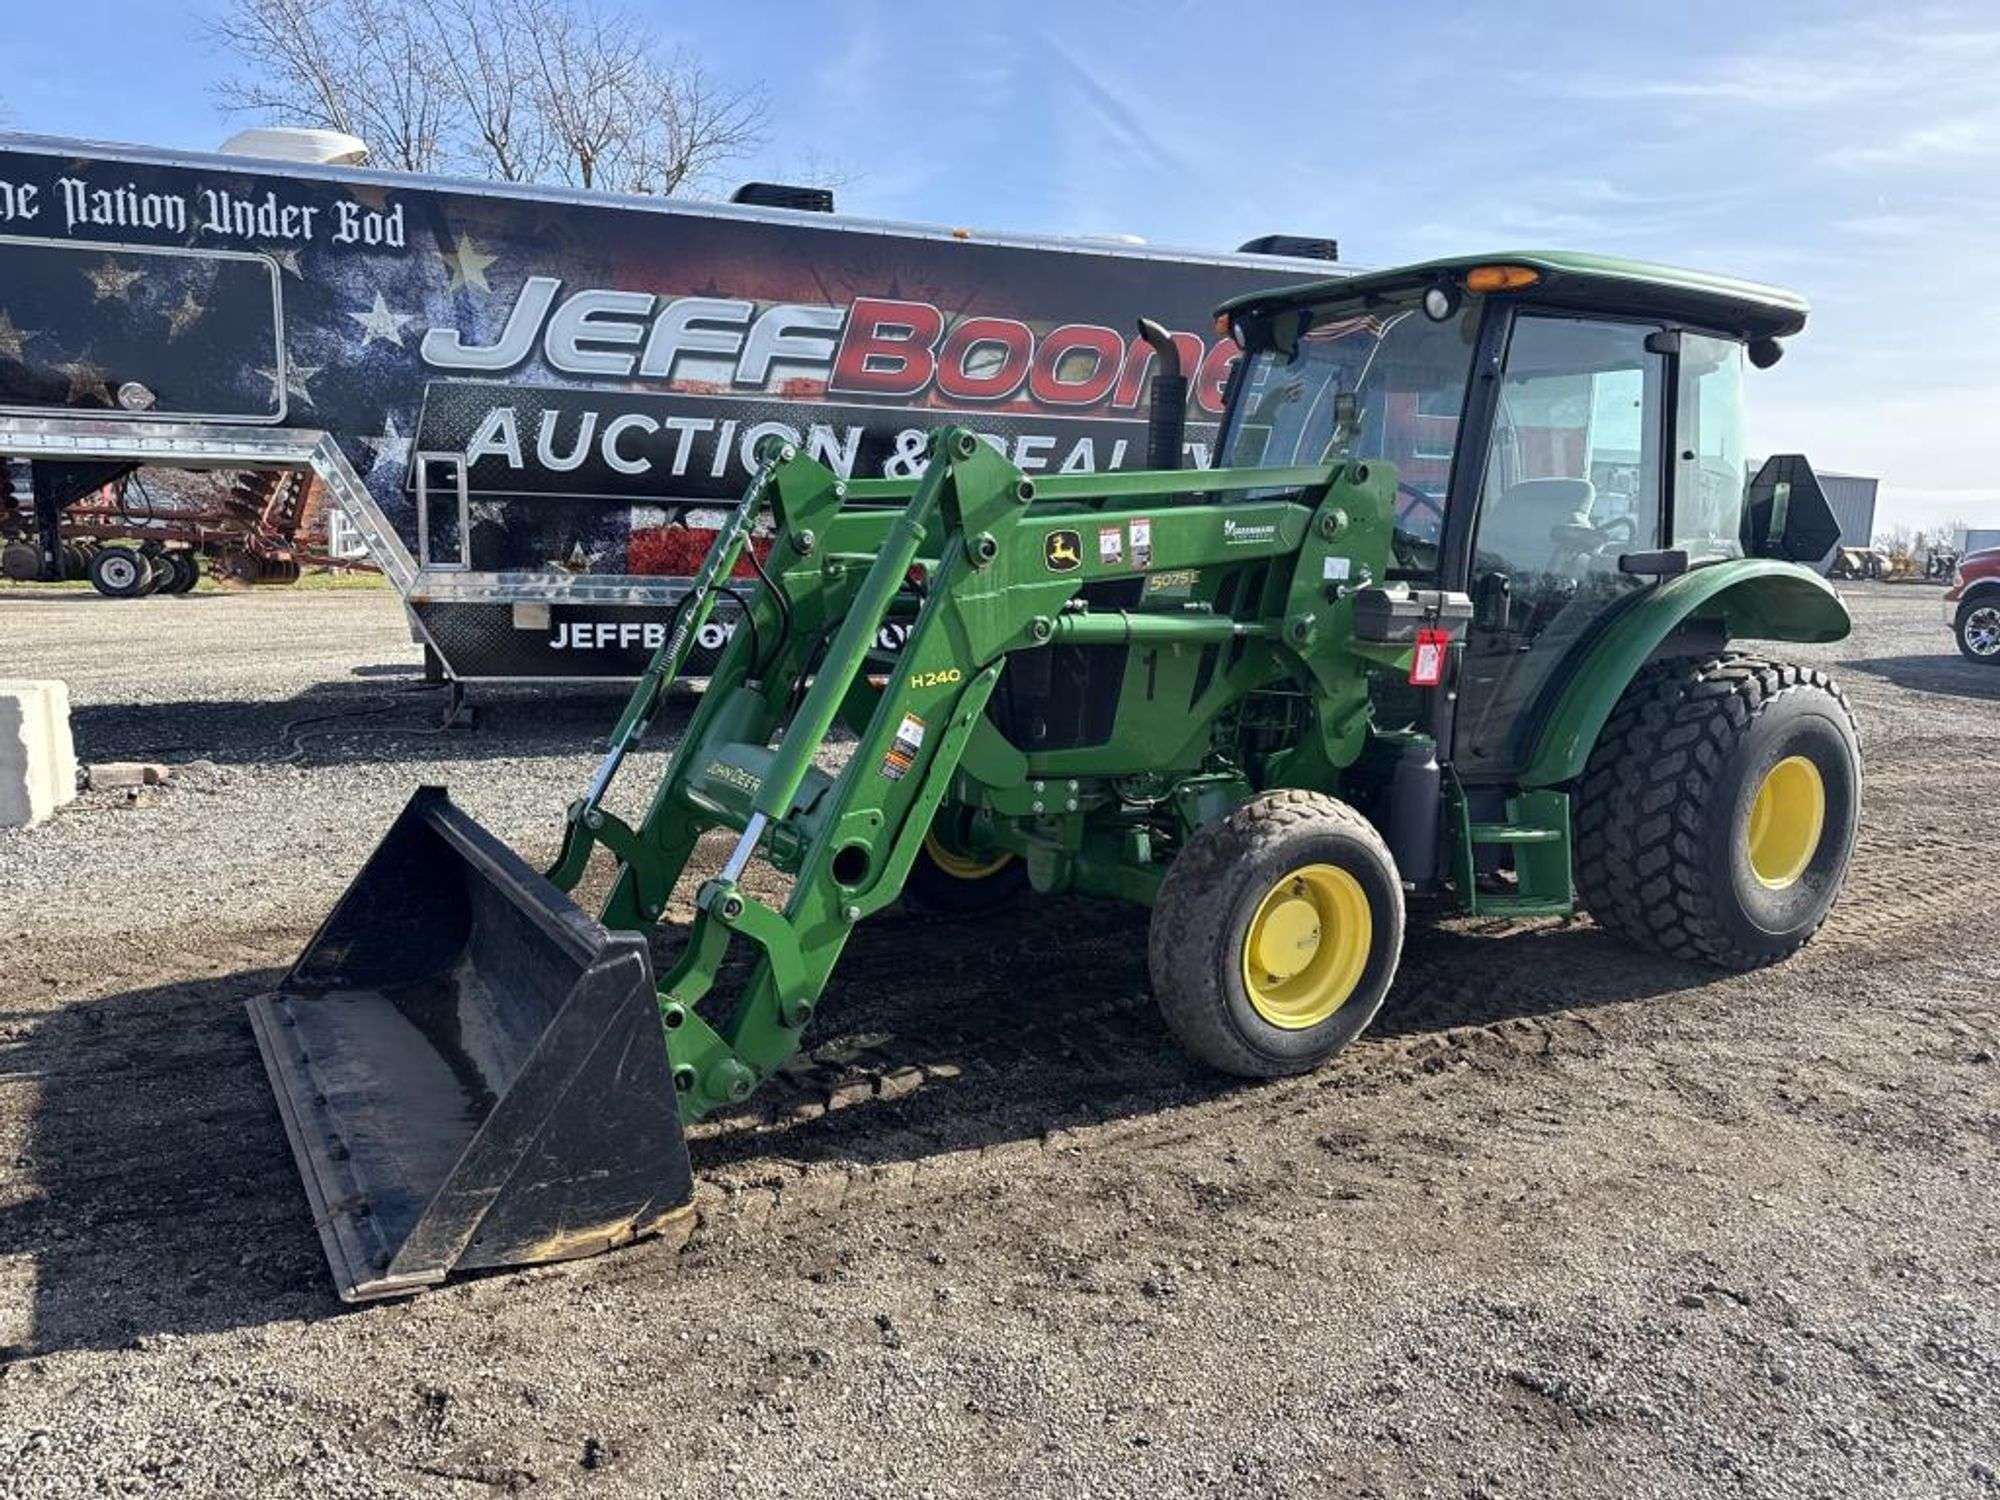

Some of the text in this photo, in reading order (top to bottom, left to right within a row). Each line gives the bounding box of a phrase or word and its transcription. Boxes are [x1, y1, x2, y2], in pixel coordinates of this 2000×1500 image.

[55, 176, 186, 234] Nation
[200, 189, 319, 239] Under
[466, 406, 863, 481] AUCTION
[884, 429, 931, 480] &
[911, 669, 961, 689] H240
[731, 767, 761, 791] DEER
